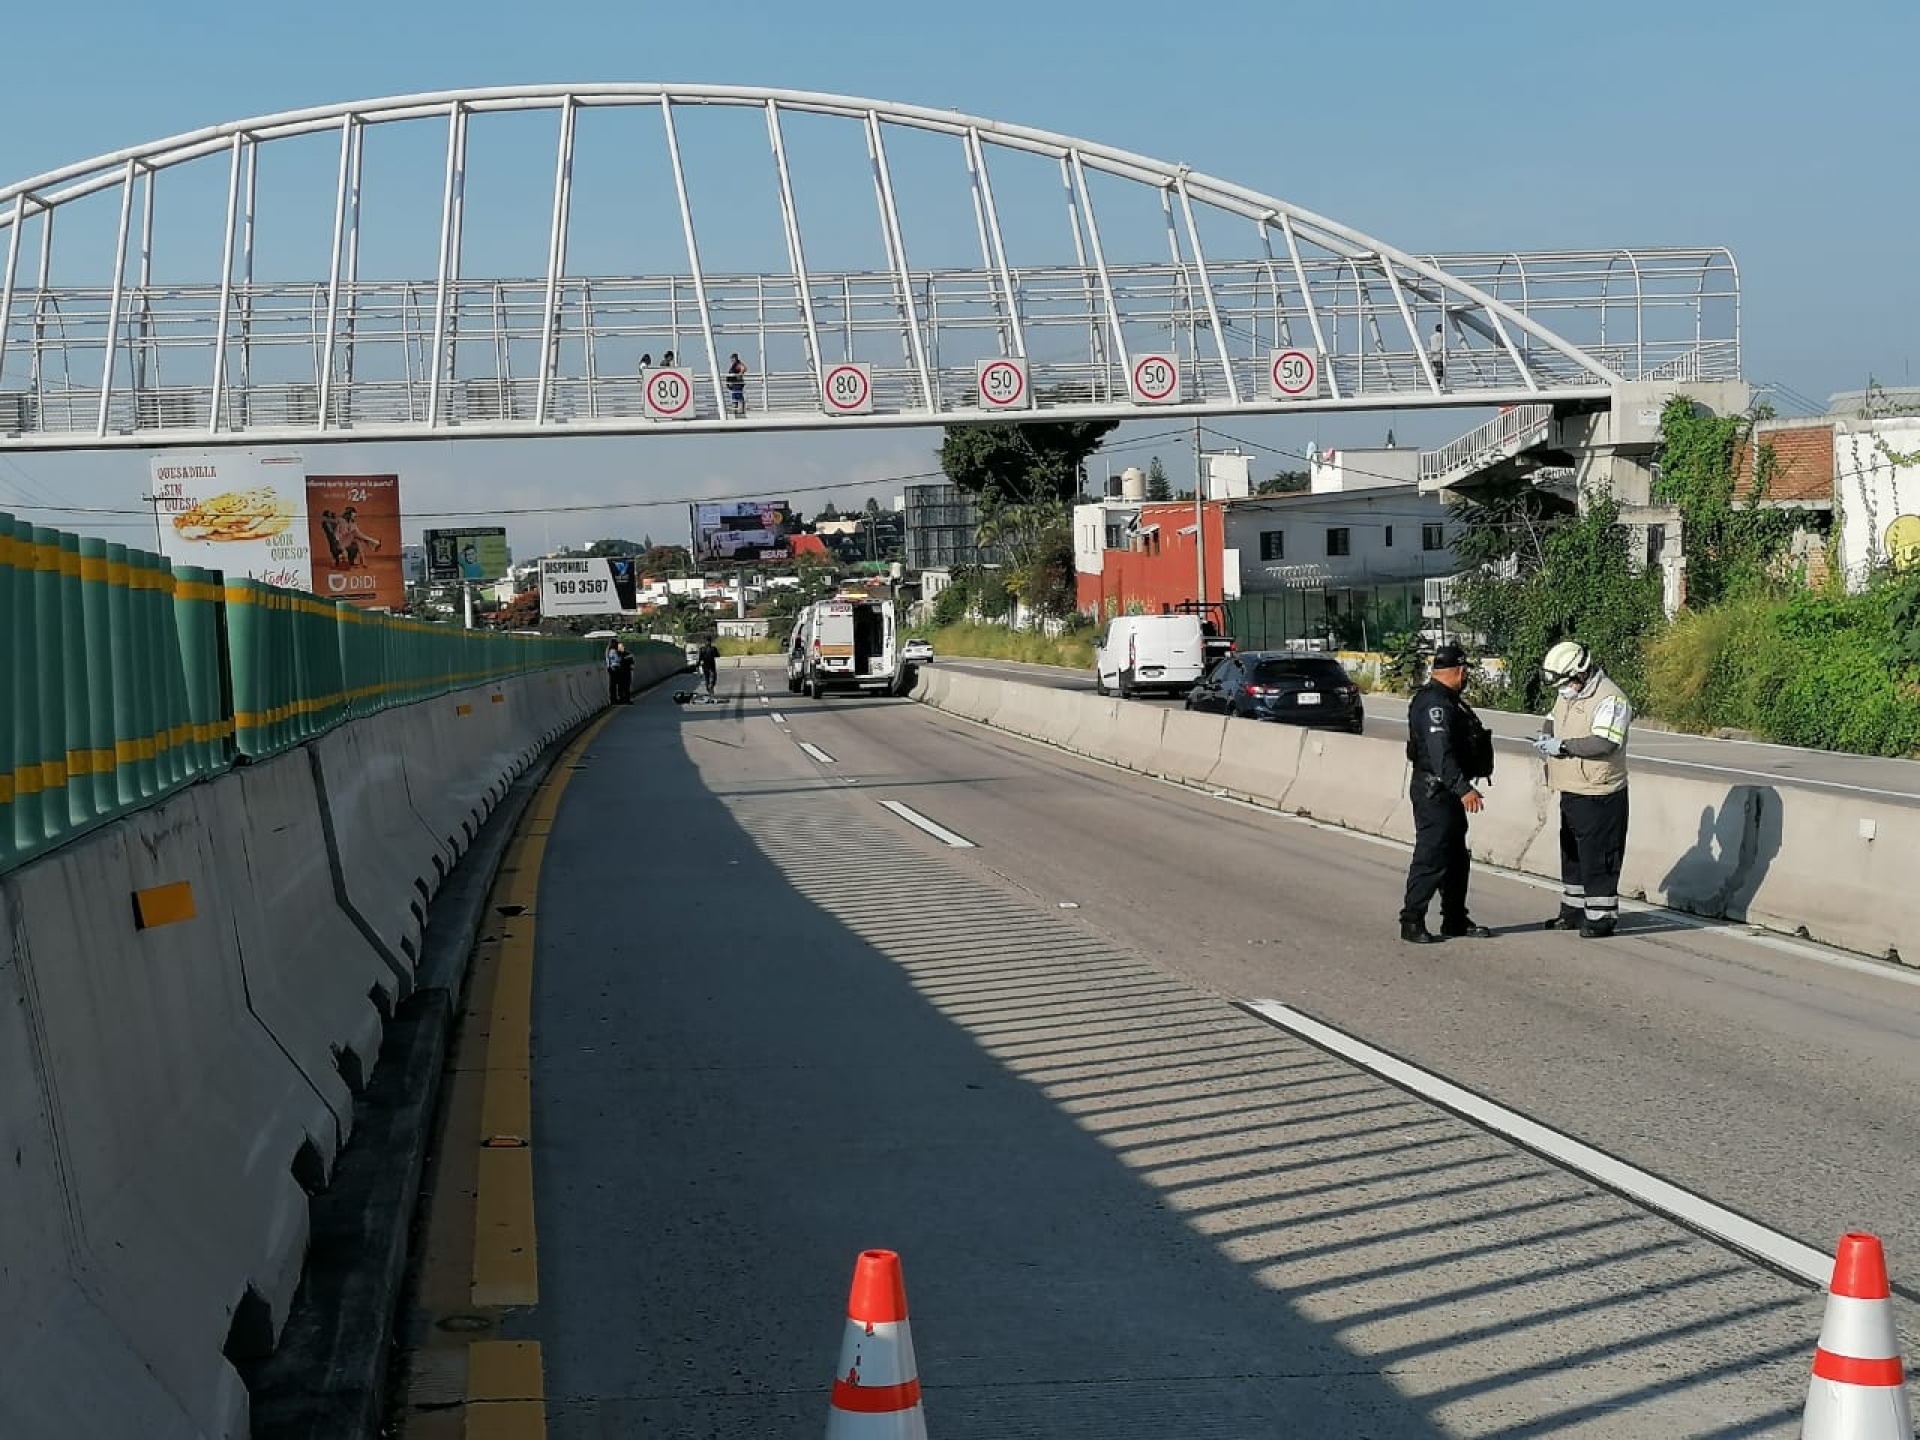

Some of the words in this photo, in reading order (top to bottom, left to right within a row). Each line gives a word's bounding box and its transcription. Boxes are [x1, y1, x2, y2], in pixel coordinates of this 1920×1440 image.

[1145, 365, 1165, 384] 50
[1283, 361, 1303, 379] 50
[836, 375, 857, 394] 80
[991, 370, 1012, 389] 50
[658, 380, 679, 398] 80
[157, 466, 217, 480] QUESADILLA
[553, 580, 575, 594] 169
[578, 579, 608, 593] 3587
